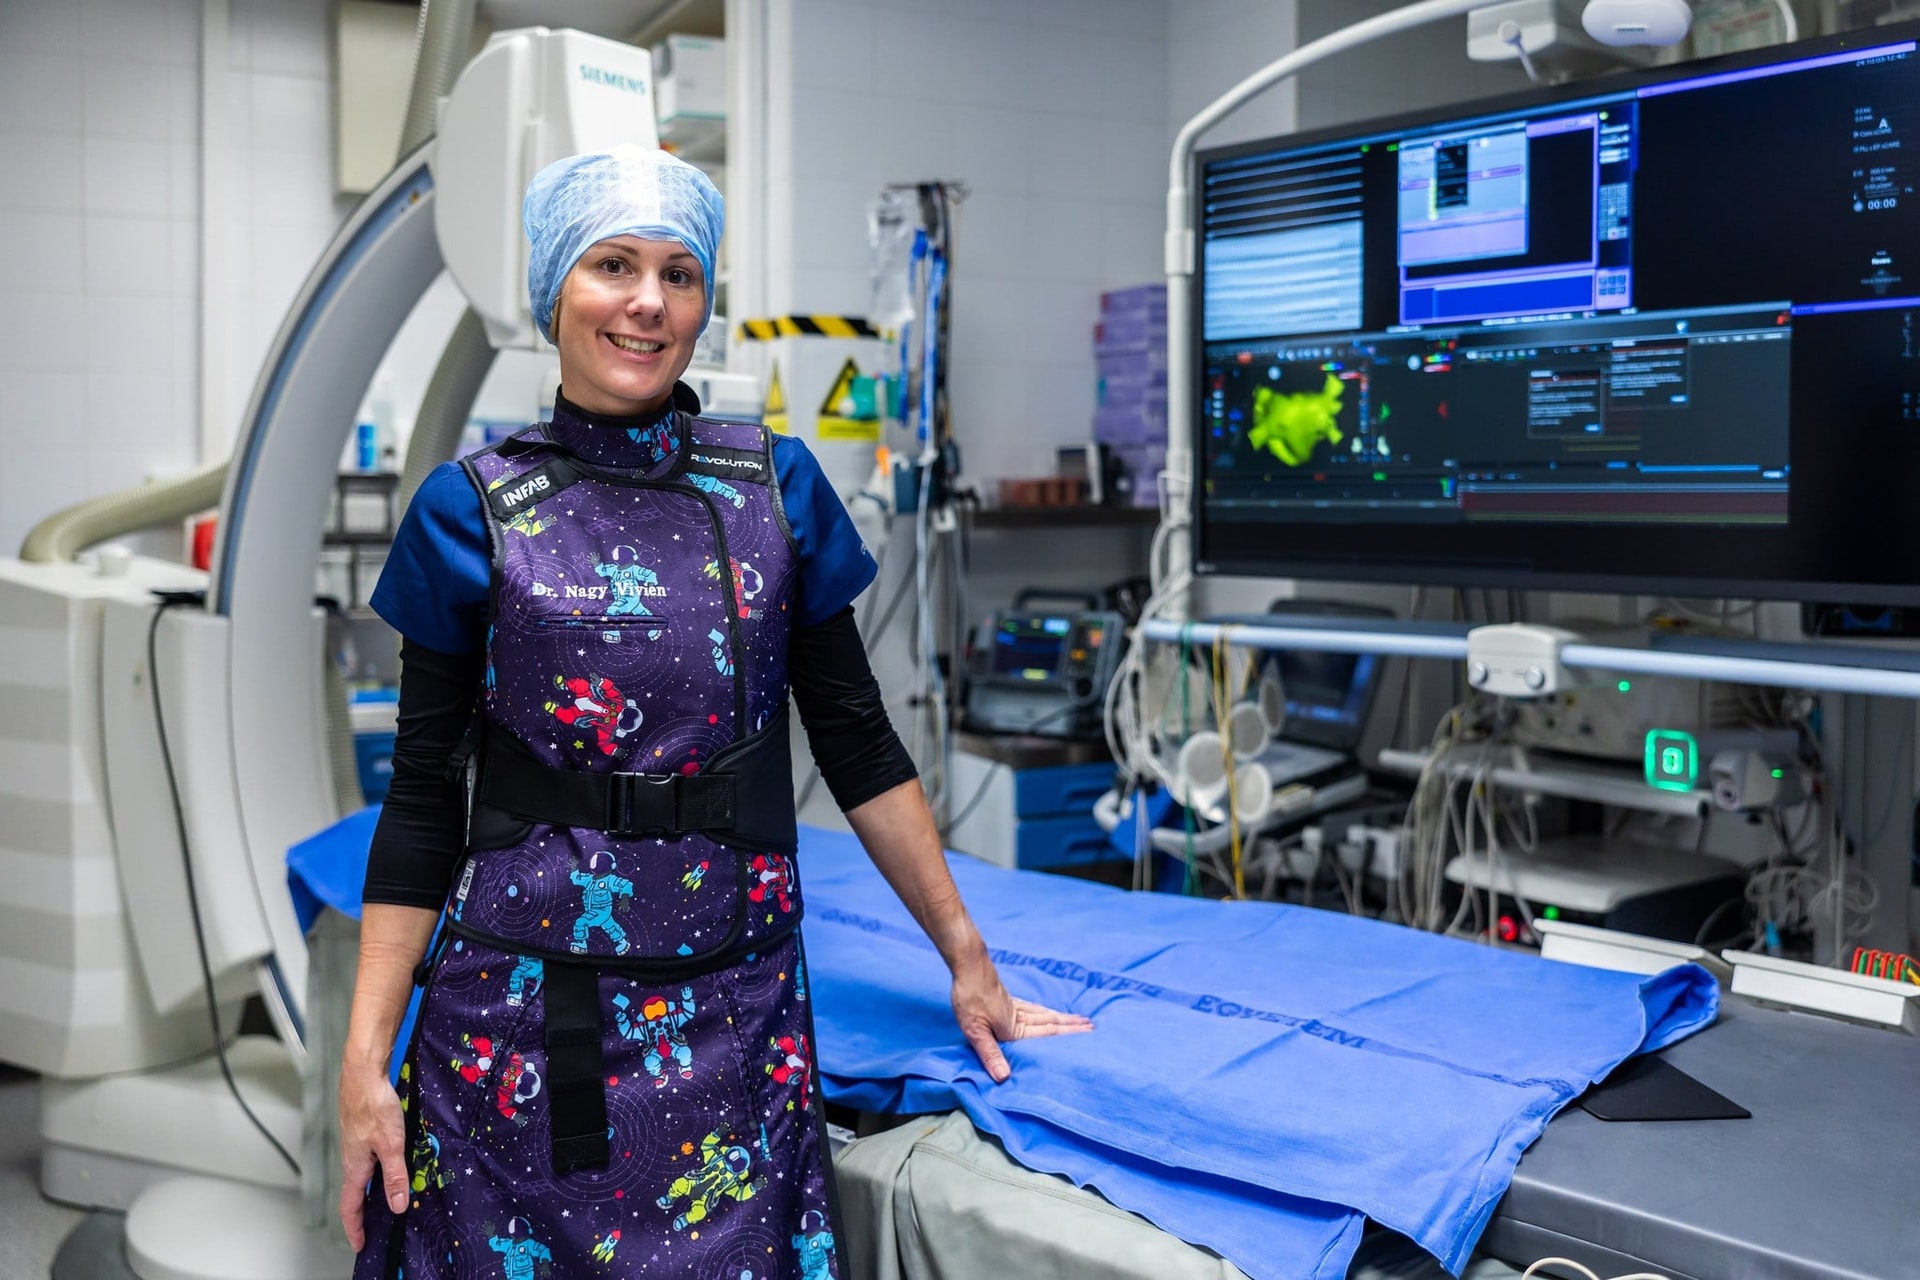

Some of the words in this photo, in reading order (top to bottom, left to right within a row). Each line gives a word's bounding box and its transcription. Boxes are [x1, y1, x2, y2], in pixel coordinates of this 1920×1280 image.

[580, 64, 646, 95] SIEMENS
[501, 474, 551, 507] INFAB
[532, 582, 559, 598] Dr.
[564, 585, 608, 600] Nagy
[615, 582, 668, 598] Vivien
